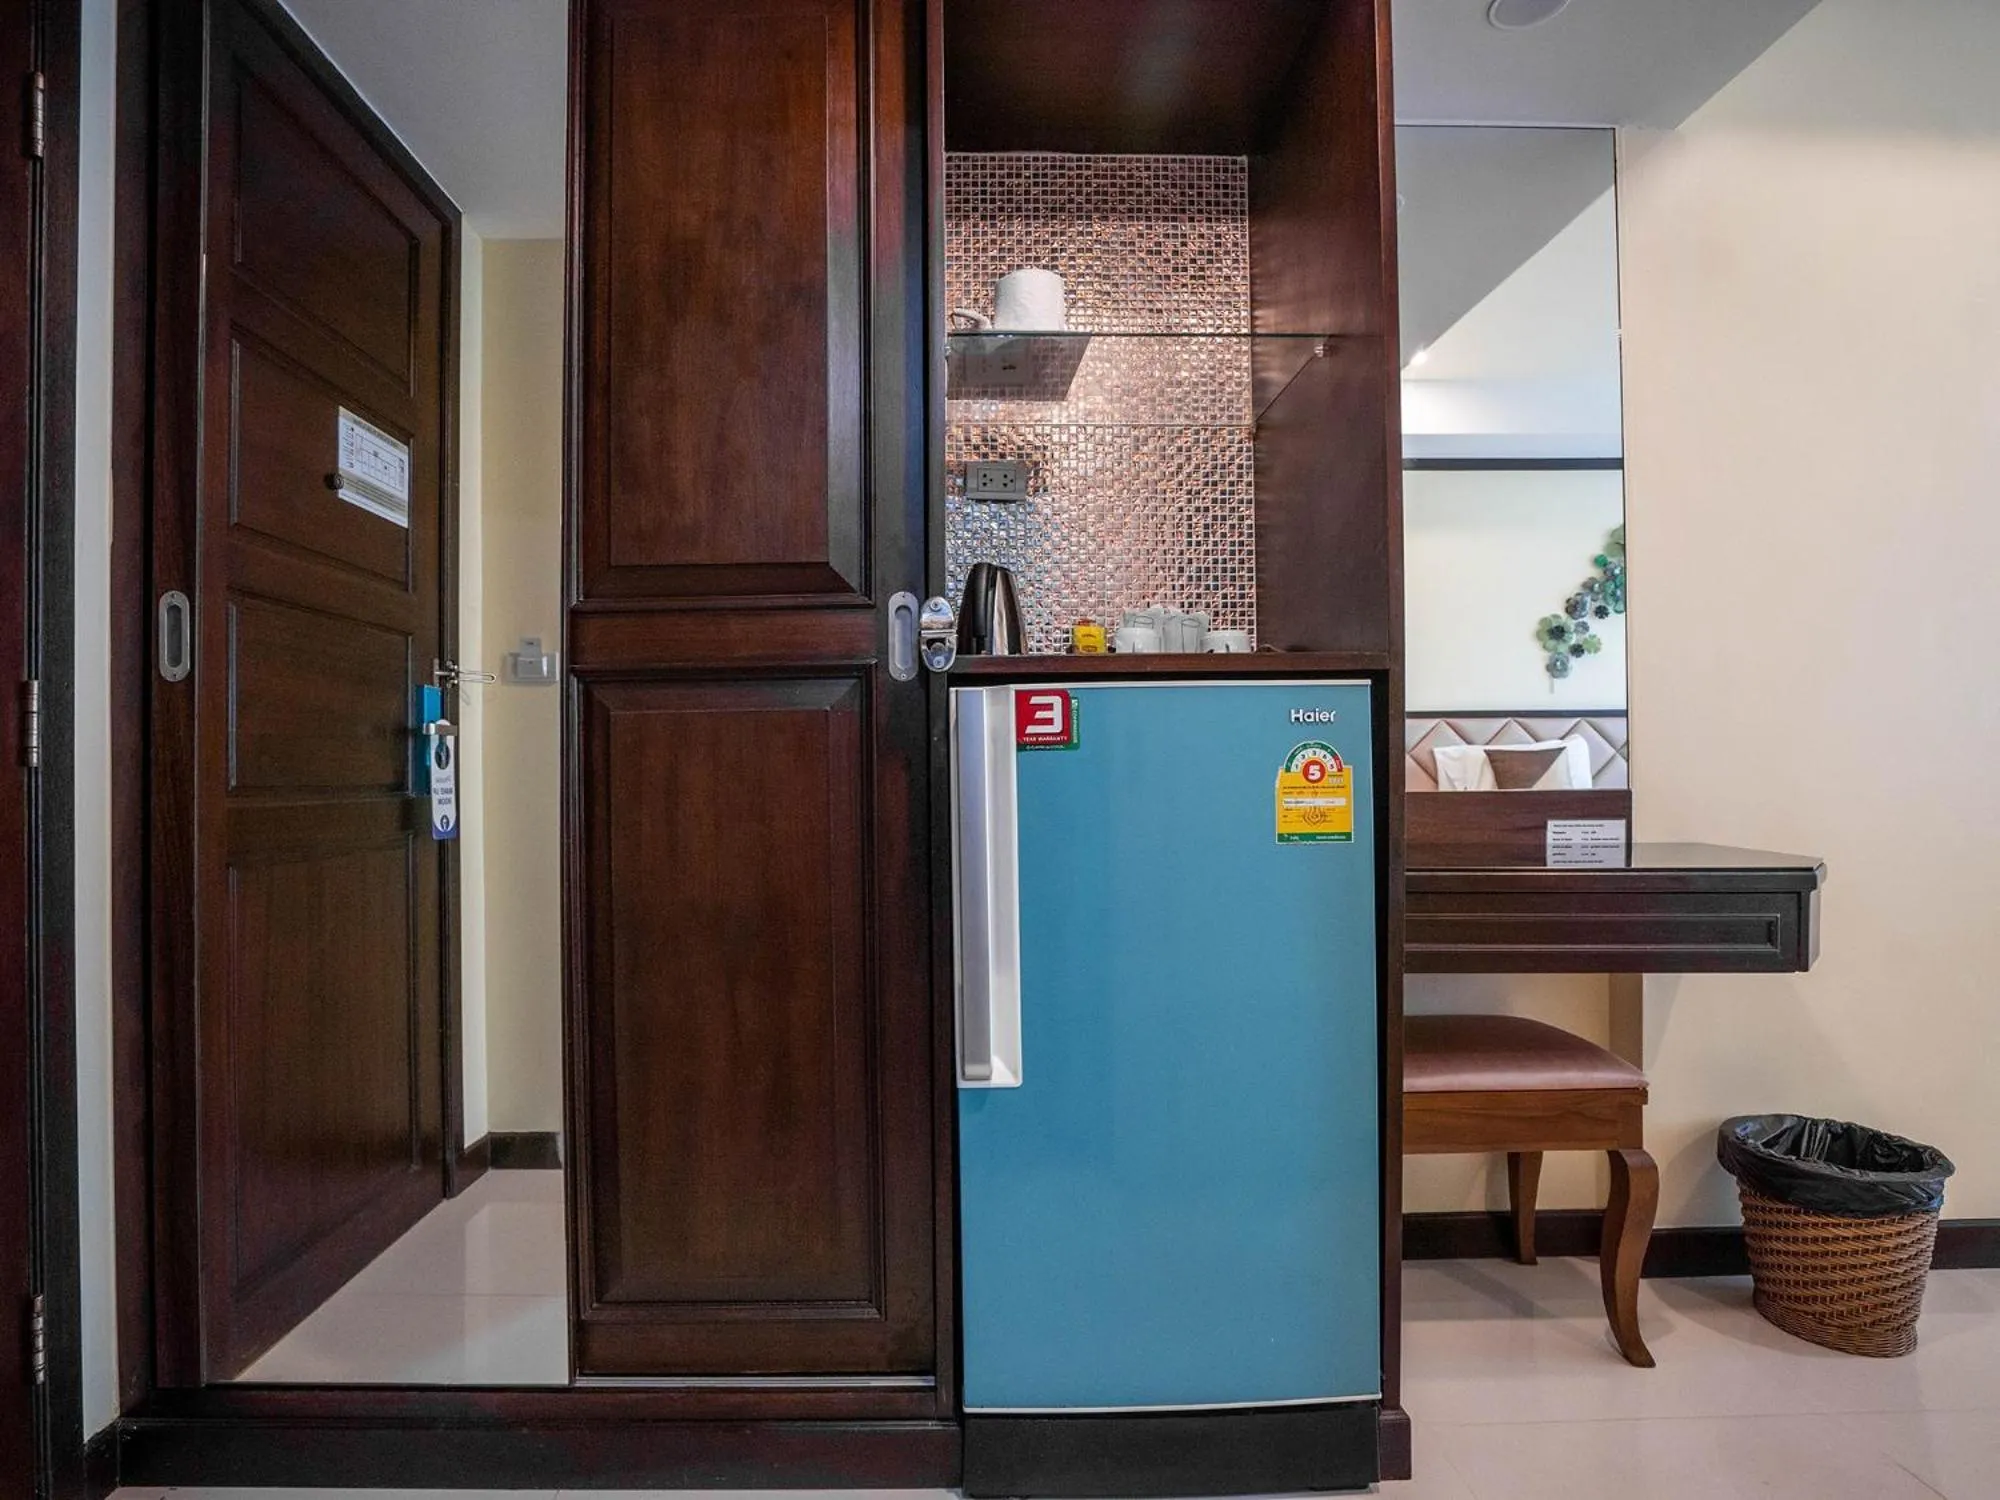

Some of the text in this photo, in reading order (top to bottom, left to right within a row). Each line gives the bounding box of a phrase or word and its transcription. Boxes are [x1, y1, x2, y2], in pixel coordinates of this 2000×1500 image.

[1025, 695, 1063, 734] 3
[1291, 708, 1336, 723] Haier
[1308, 765, 1321, 781] 5
